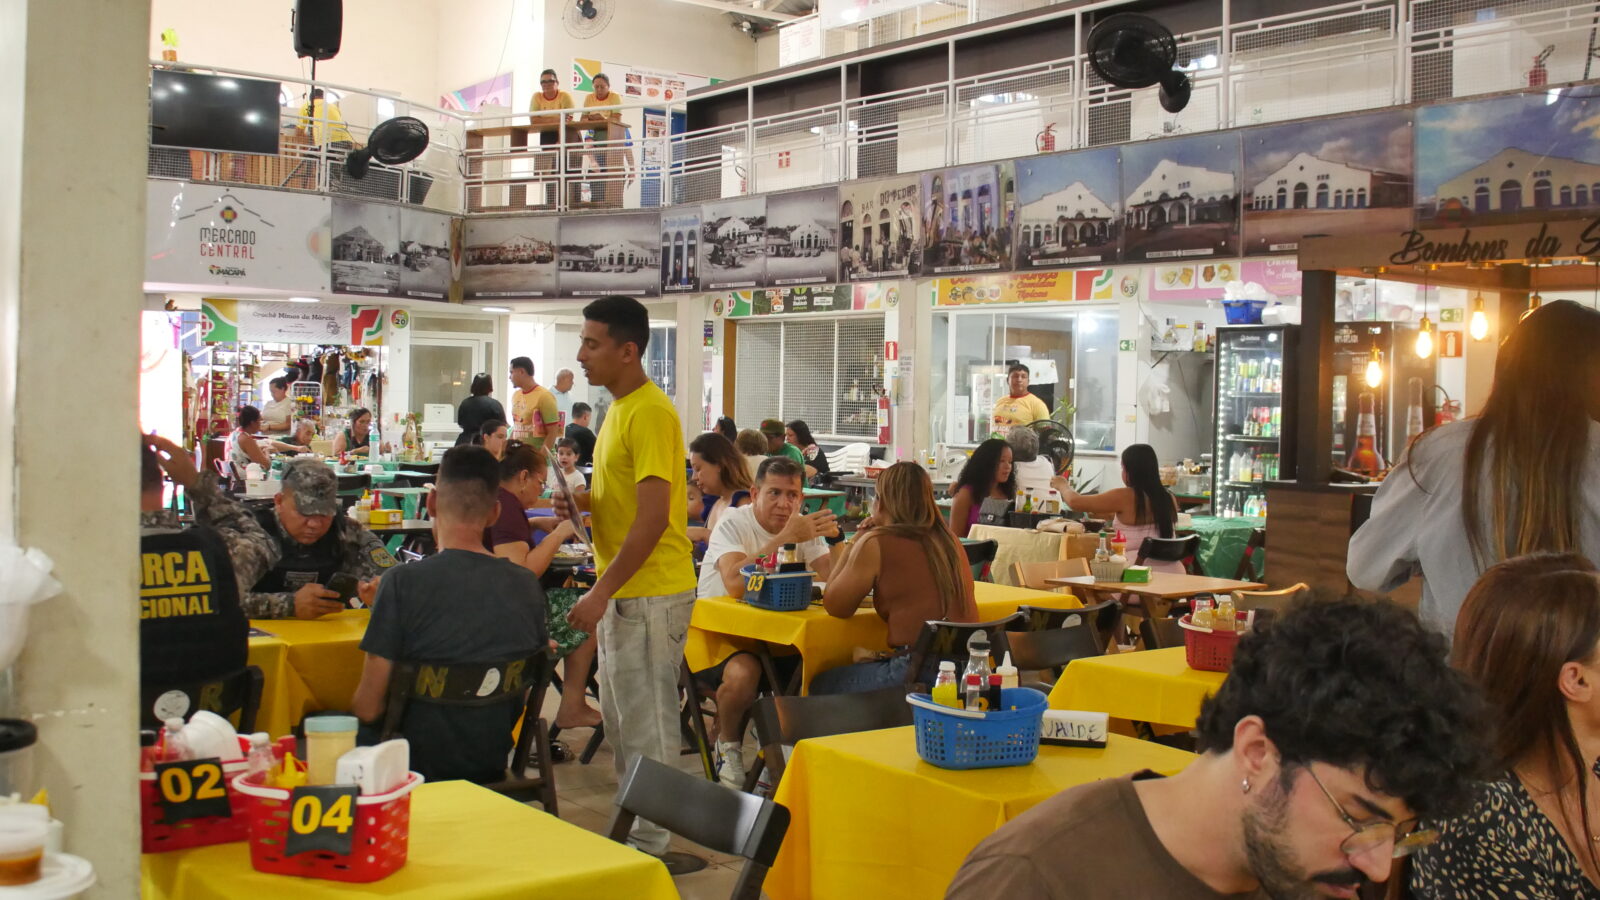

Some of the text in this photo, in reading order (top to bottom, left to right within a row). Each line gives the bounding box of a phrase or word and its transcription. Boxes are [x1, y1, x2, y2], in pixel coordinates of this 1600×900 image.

[200, 227, 256, 246] MERCADO
[200, 243, 255, 260] CENTRAL
[1389, 228, 1509, 266] Bombons
[1524, 222, 1563, 258] da
[140, 550, 211, 588] RÇA
[747, 574, 765, 592] 03
[139, 594, 214, 620] CIONAL
[160, 762, 226, 804] 02
[291, 794, 354, 835] 04
